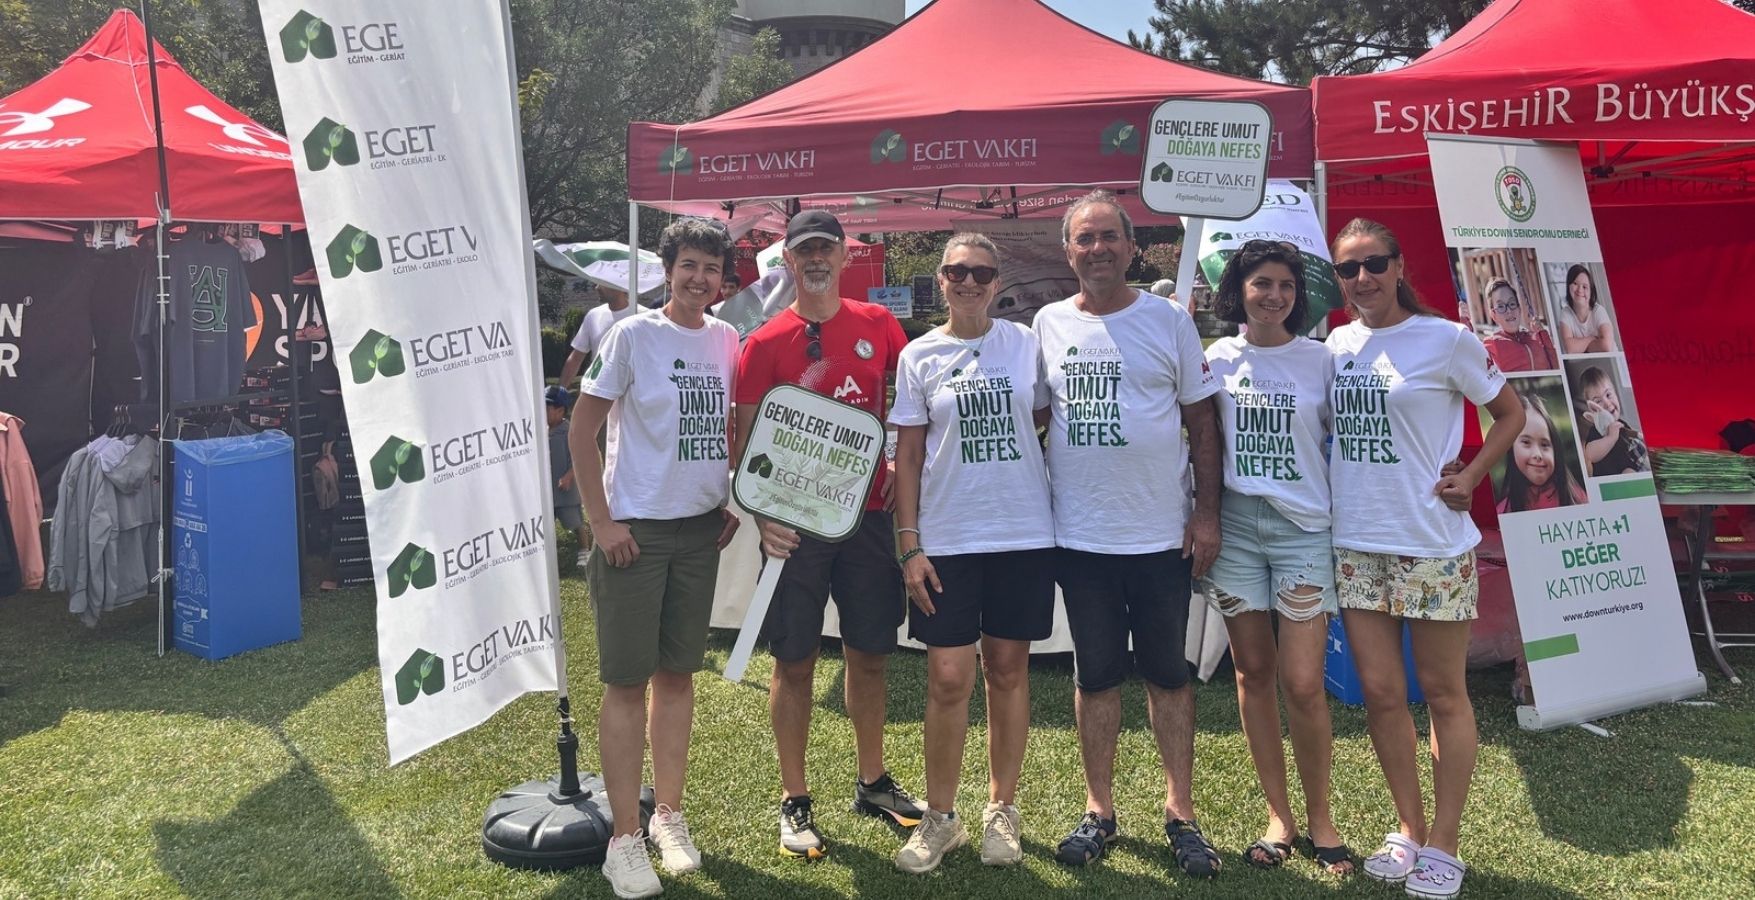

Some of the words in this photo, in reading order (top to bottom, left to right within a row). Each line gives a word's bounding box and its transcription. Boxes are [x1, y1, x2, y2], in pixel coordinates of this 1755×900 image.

[341, 23, 404, 53] EGE
[347, 55, 374, 64] EĞİTİM
[1374, 87, 1574, 135] ESKİŞEHİR
[1154, 119, 1219, 138] GENÇLERE
[1222, 122, 1260, 139] UMUT
[364, 125, 435, 159] EGET
[914, 140, 969, 161] EGET
[973, 138, 1037, 159] VAKFI
[1167, 137, 1216, 157] DOĞAYA
[1220, 142, 1261, 159] NEFES
[699, 154, 751, 174] EGET
[755, 150, 815, 171] VAKFI
[1176, 170, 1213, 184] EGET
[1215, 173, 1256, 187] VAKFI
[387, 227, 454, 263] EGET
[1452, 226, 1486, 238] TÜRKİYE
[1487, 228, 1513, 238] DOWN
[1514, 228, 1556, 239] SENDROMU
[1556, 227, 1590, 239] DERNEĞİ
[274, 335, 337, 372] SP
[409, 327, 473, 367] EGET
[477, 321, 512, 350] VA
[1066, 361, 1121, 377] GENÇLERE
[1335, 374, 1393, 388] GENÇLERE
[677, 375, 724, 391] GENÇLERE
[953, 376, 1012, 393] GENÇLERE
[1066, 376, 1121, 401] UMUT
[679, 391, 725, 415] UMUT
[955, 389, 1013, 418] UMUT
[1067, 401, 1120, 421] DOĞAYA
[1236, 393, 1296, 409] GENÇLERE
[1335, 388, 1389, 415] UMUT
[679, 416, 725, 436] DOĞAYA
[764, 401, 833, 439] GENÇLERE
[833, 425, 874, 453] UMUT
[959, 416, 1015, 439] DOĞAYA
[1236, 407, 1295, 434] UMUT
[1336, 414, 1392, 437] DOĞAYA
[431, 429, 487, 473] EGET
[492, 418, 532, 451] VAK
[1068, 422, 1121, 447] NEFES
[1236, 433, 1295, 455] DOĞAYA
[678, 437, 725, 461] NEFES
[772, 428, 825, 459] DOĞAYA
[826, 446, 870, 476] NEFES
[961, 437, 1018, 464] NEFES
[1339, 437, 1393, 464] NEFES
[1235, 455, 1297, 481] NEFES
[775, 467, 813, 491] EGET
[815, 481, 856, 508] VAKFI
[1538, 517, 1611, 544] HAYATA
[1612, 514, 1630, 534] +1
[443, 530, 494, 578] EGET
[499, 516, 544, 551] VAK
[1561, 541, 1621, 569] DEĞER
[1545, 565, 1647, 601] KATIYORUZ!
[1562, 602, 1644, 622] www.downturkiye.org
[452, 629, 499, 682] EGET
[503, 614, 553, 648] VAK
